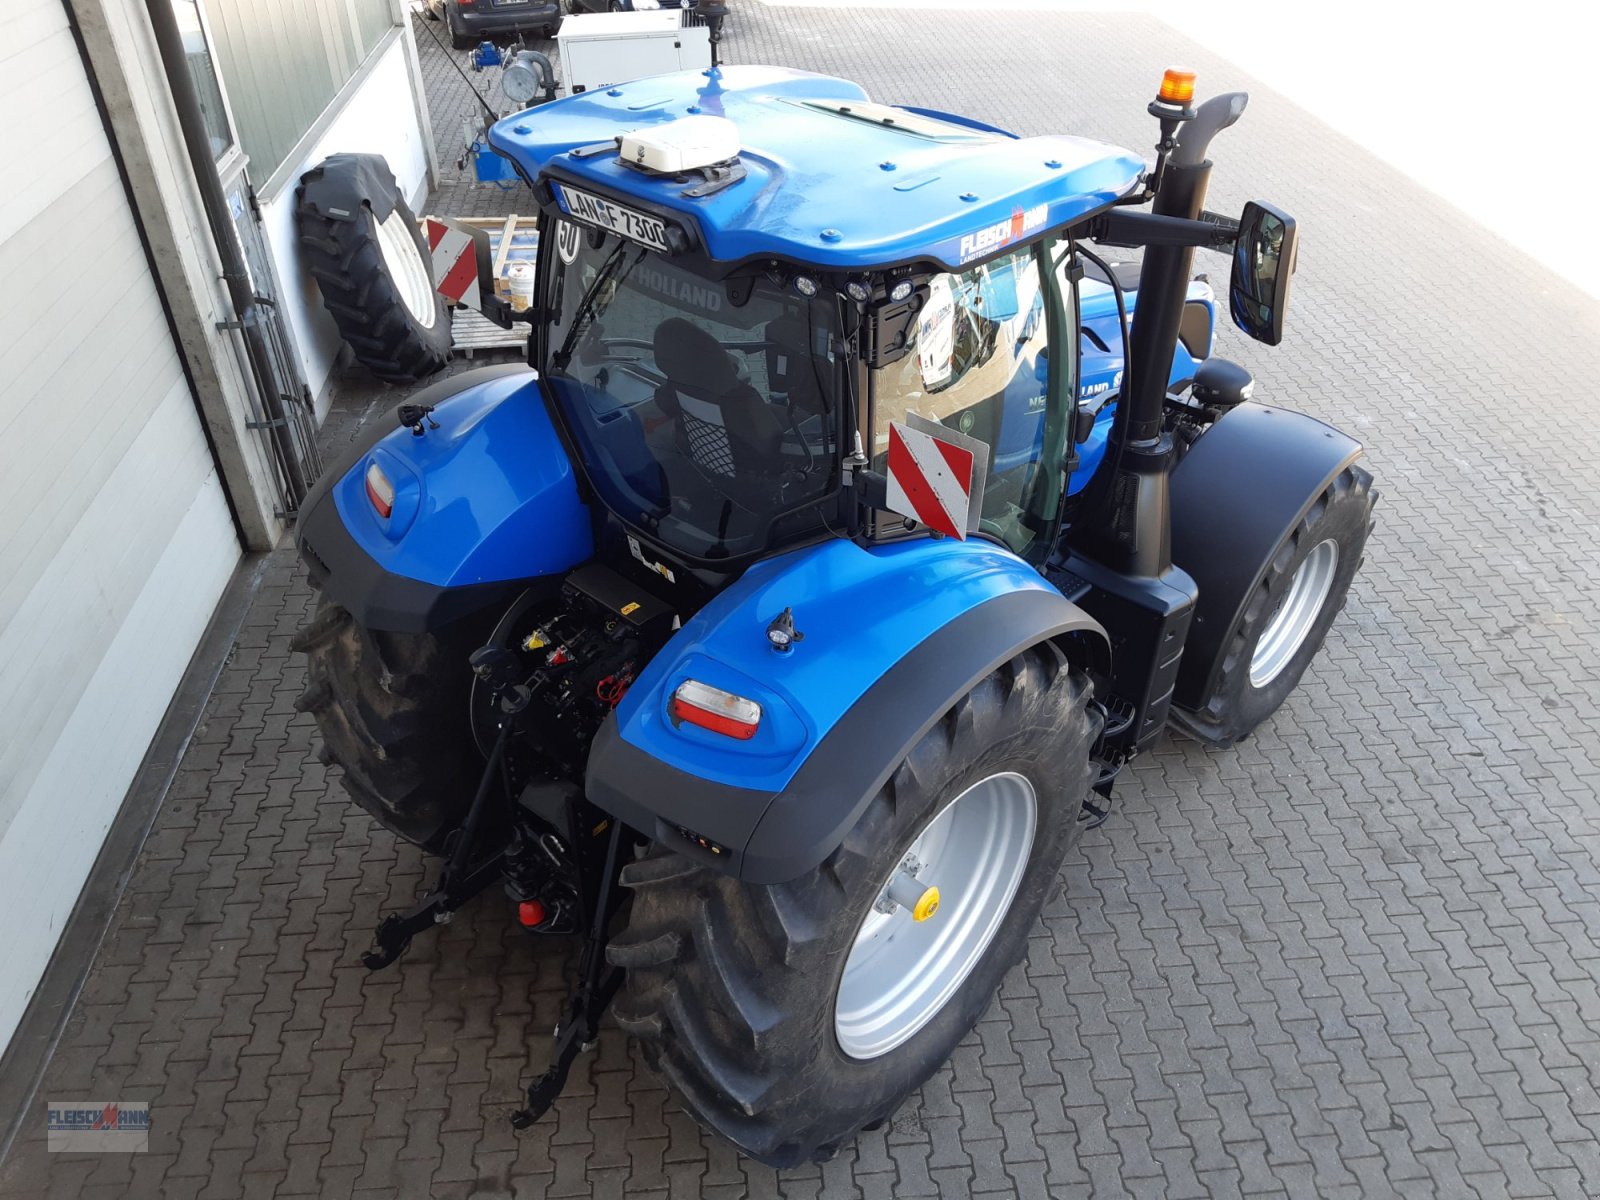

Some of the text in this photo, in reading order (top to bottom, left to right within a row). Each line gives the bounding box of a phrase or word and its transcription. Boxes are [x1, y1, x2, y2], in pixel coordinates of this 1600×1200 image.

[560, 221, 577, 257] 50
[563, 189, 665, 246] LAN F 7300
[960, 204, 1049, 257] FLEISCHMANN
[638, 265, 721, 312] HOLLAND
[1028, 382, 1109, 407] NE LAND
